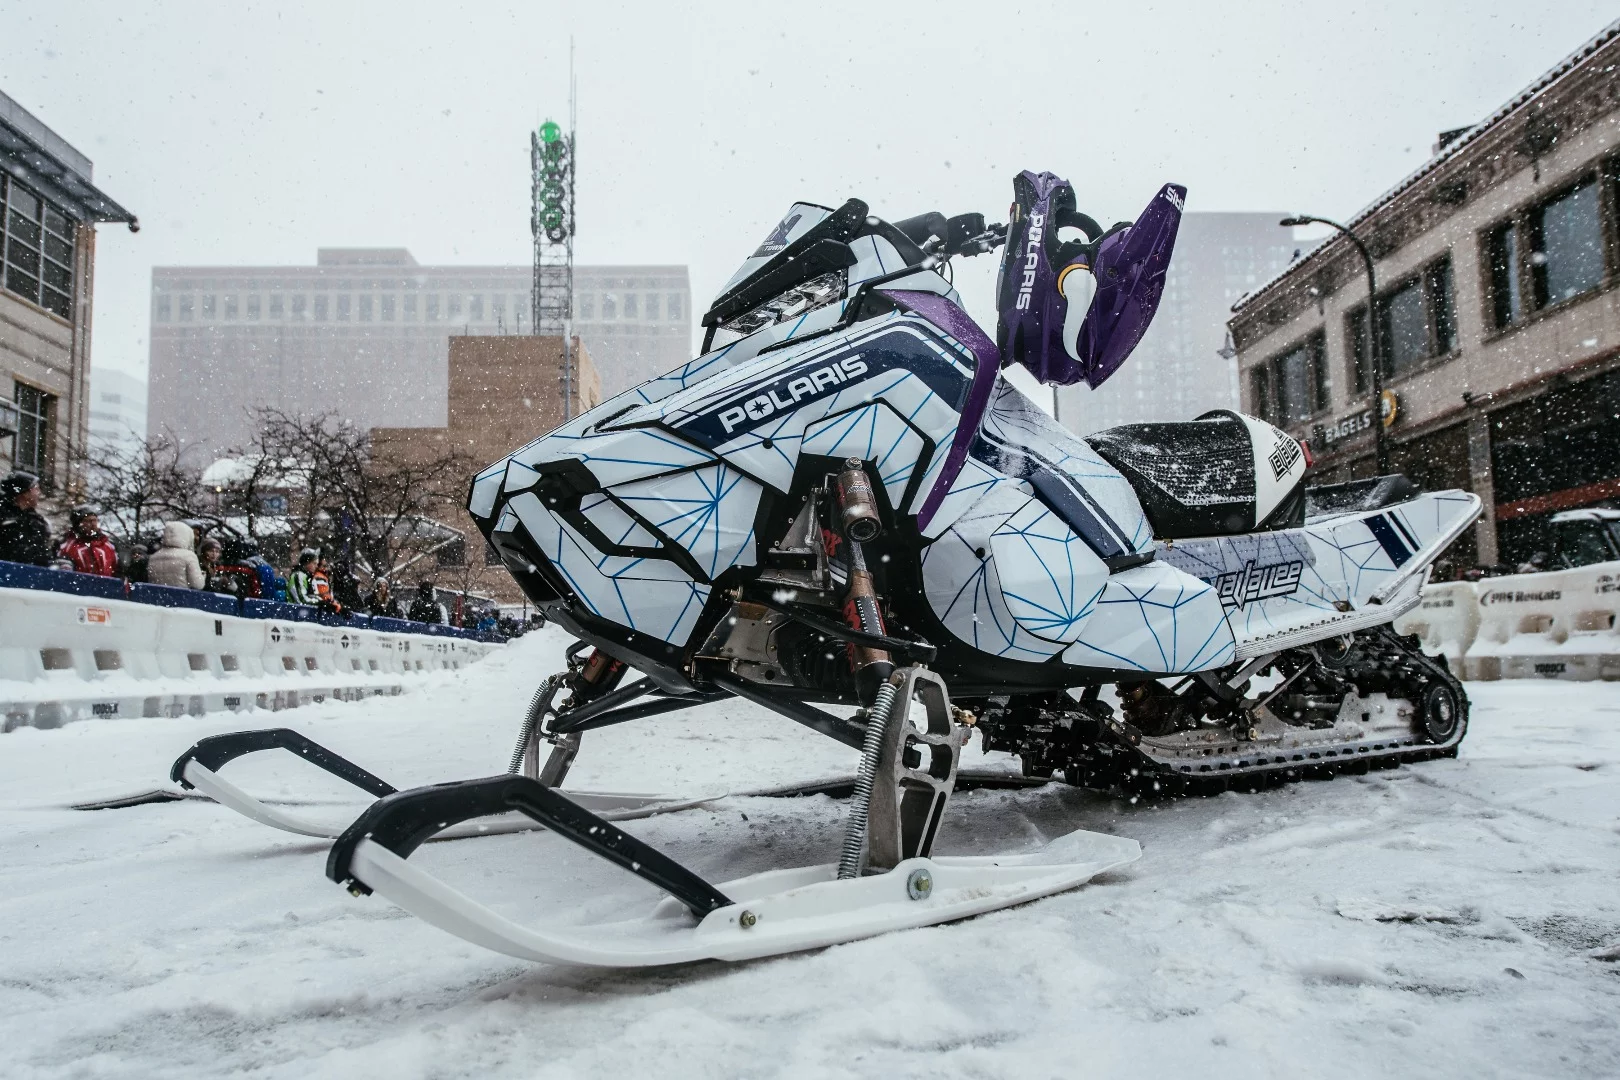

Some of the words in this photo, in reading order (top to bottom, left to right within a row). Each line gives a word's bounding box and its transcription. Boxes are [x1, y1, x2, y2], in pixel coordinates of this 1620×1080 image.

[1015, 213, 1045, 312] POLARIS
[717, 353, 869, 434] POLARIS
[1325, 410, 1373, 443] BAGELS
